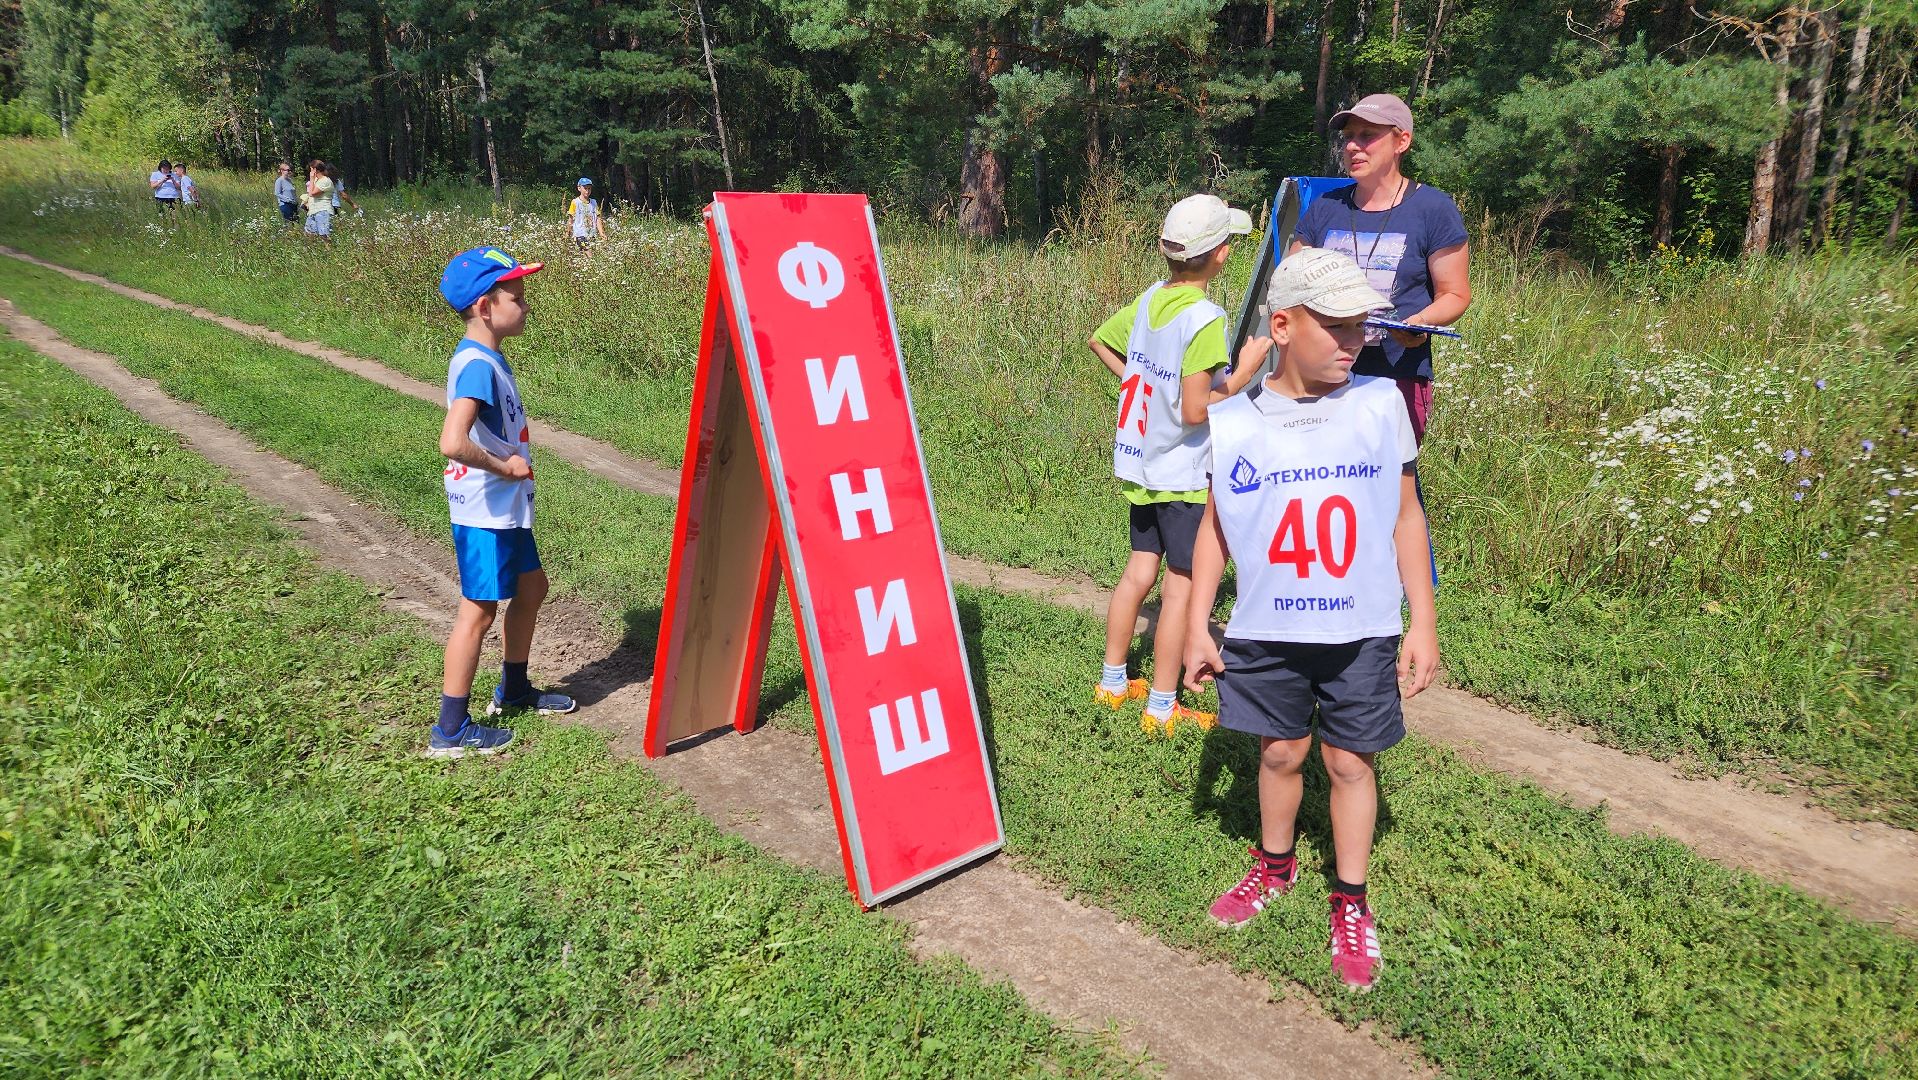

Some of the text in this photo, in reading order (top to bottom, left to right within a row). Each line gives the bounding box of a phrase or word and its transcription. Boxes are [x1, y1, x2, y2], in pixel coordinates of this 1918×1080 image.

[1118, 373, 1153, 438] 15
[1264, 461, 1382, 485] "ТЕХНО-ЛАЙН"
[777, 242, 950, 776] ФИНИШ
[1268, 494, 1357, 579] 40
[1274, 596, 1355, 611] ПРОТВИНО
